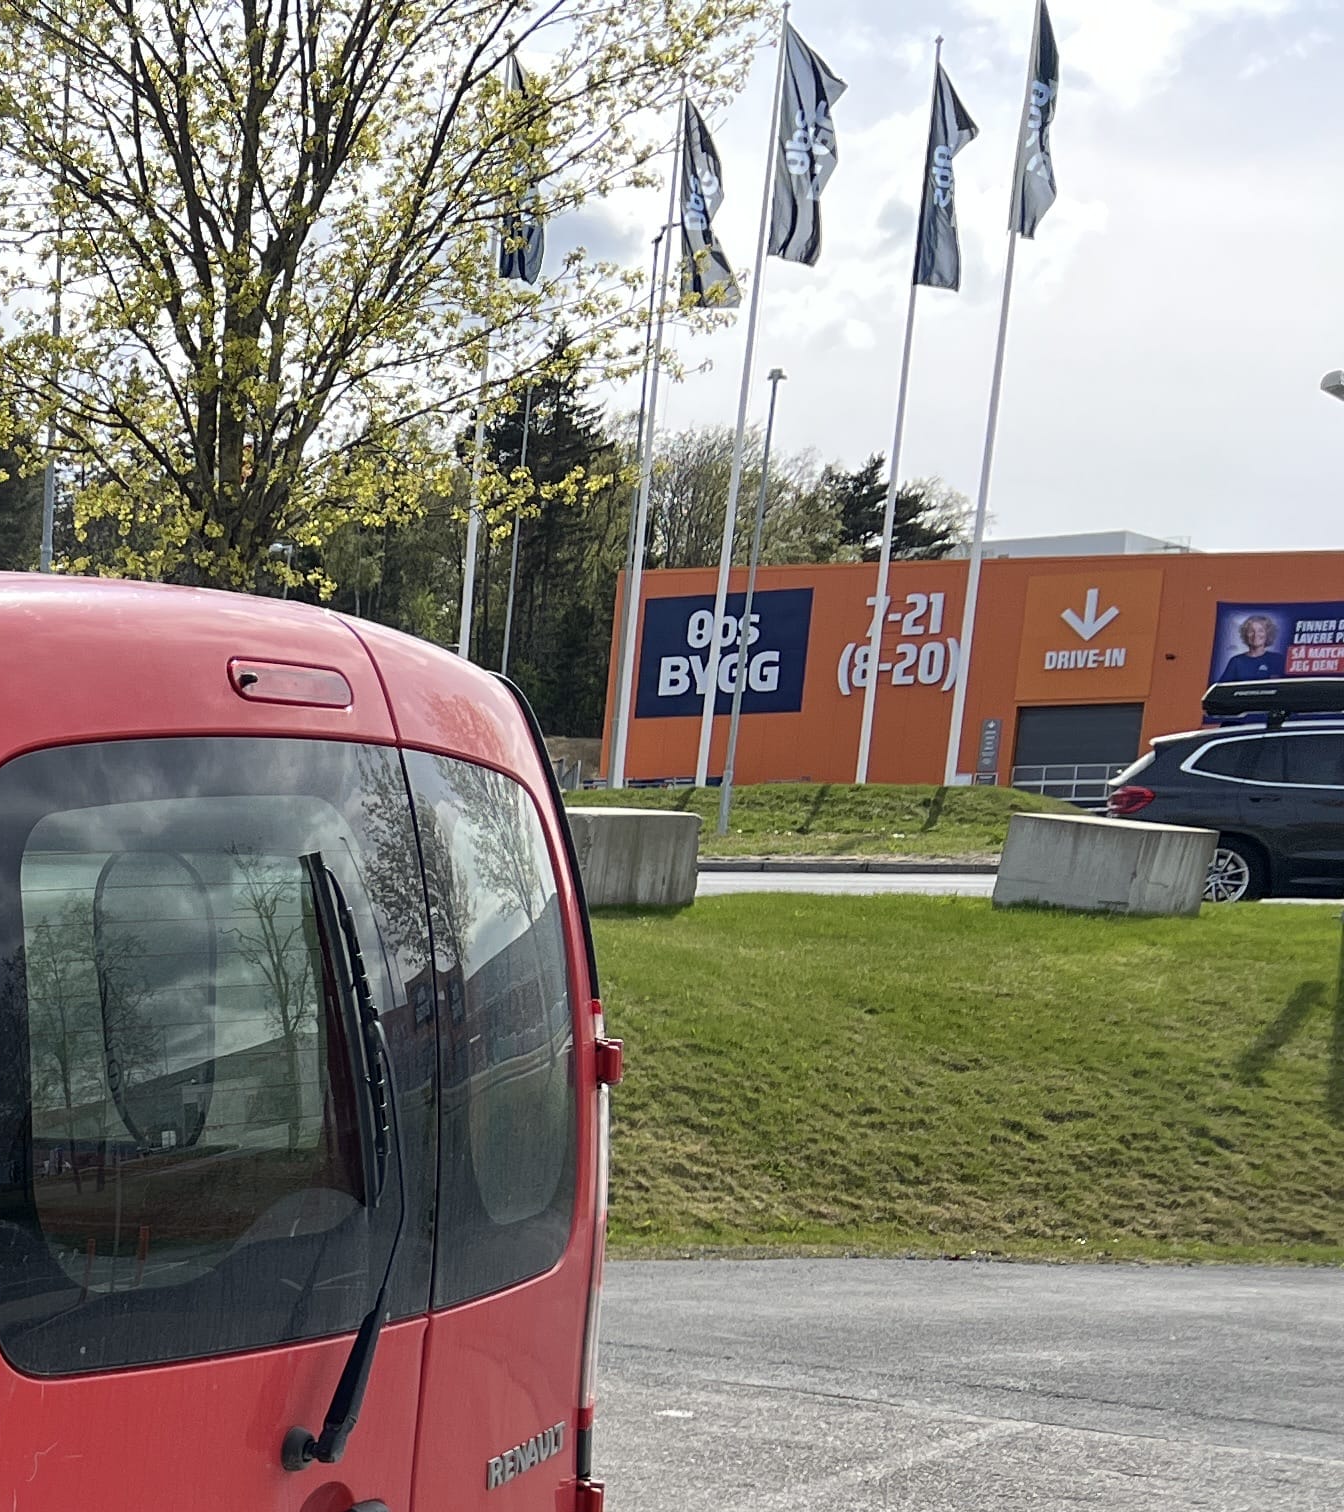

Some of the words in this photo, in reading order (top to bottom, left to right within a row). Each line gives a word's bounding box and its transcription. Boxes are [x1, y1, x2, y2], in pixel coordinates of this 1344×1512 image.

[1295, 620, 1337, 633] FINNER
[1293, 632, 1334, 645] LAVERE
[1044, 647, 1127, 670] DRIVE-IN
[1290, 645, 1306, 660] SÅ
[658, 650, 780, 697] BYGG
[1288, 660, 1310, 673] JEG
[1311, 659, 1339, 672] DEN!
[486, 1420, 566, 1490] RENAULT
